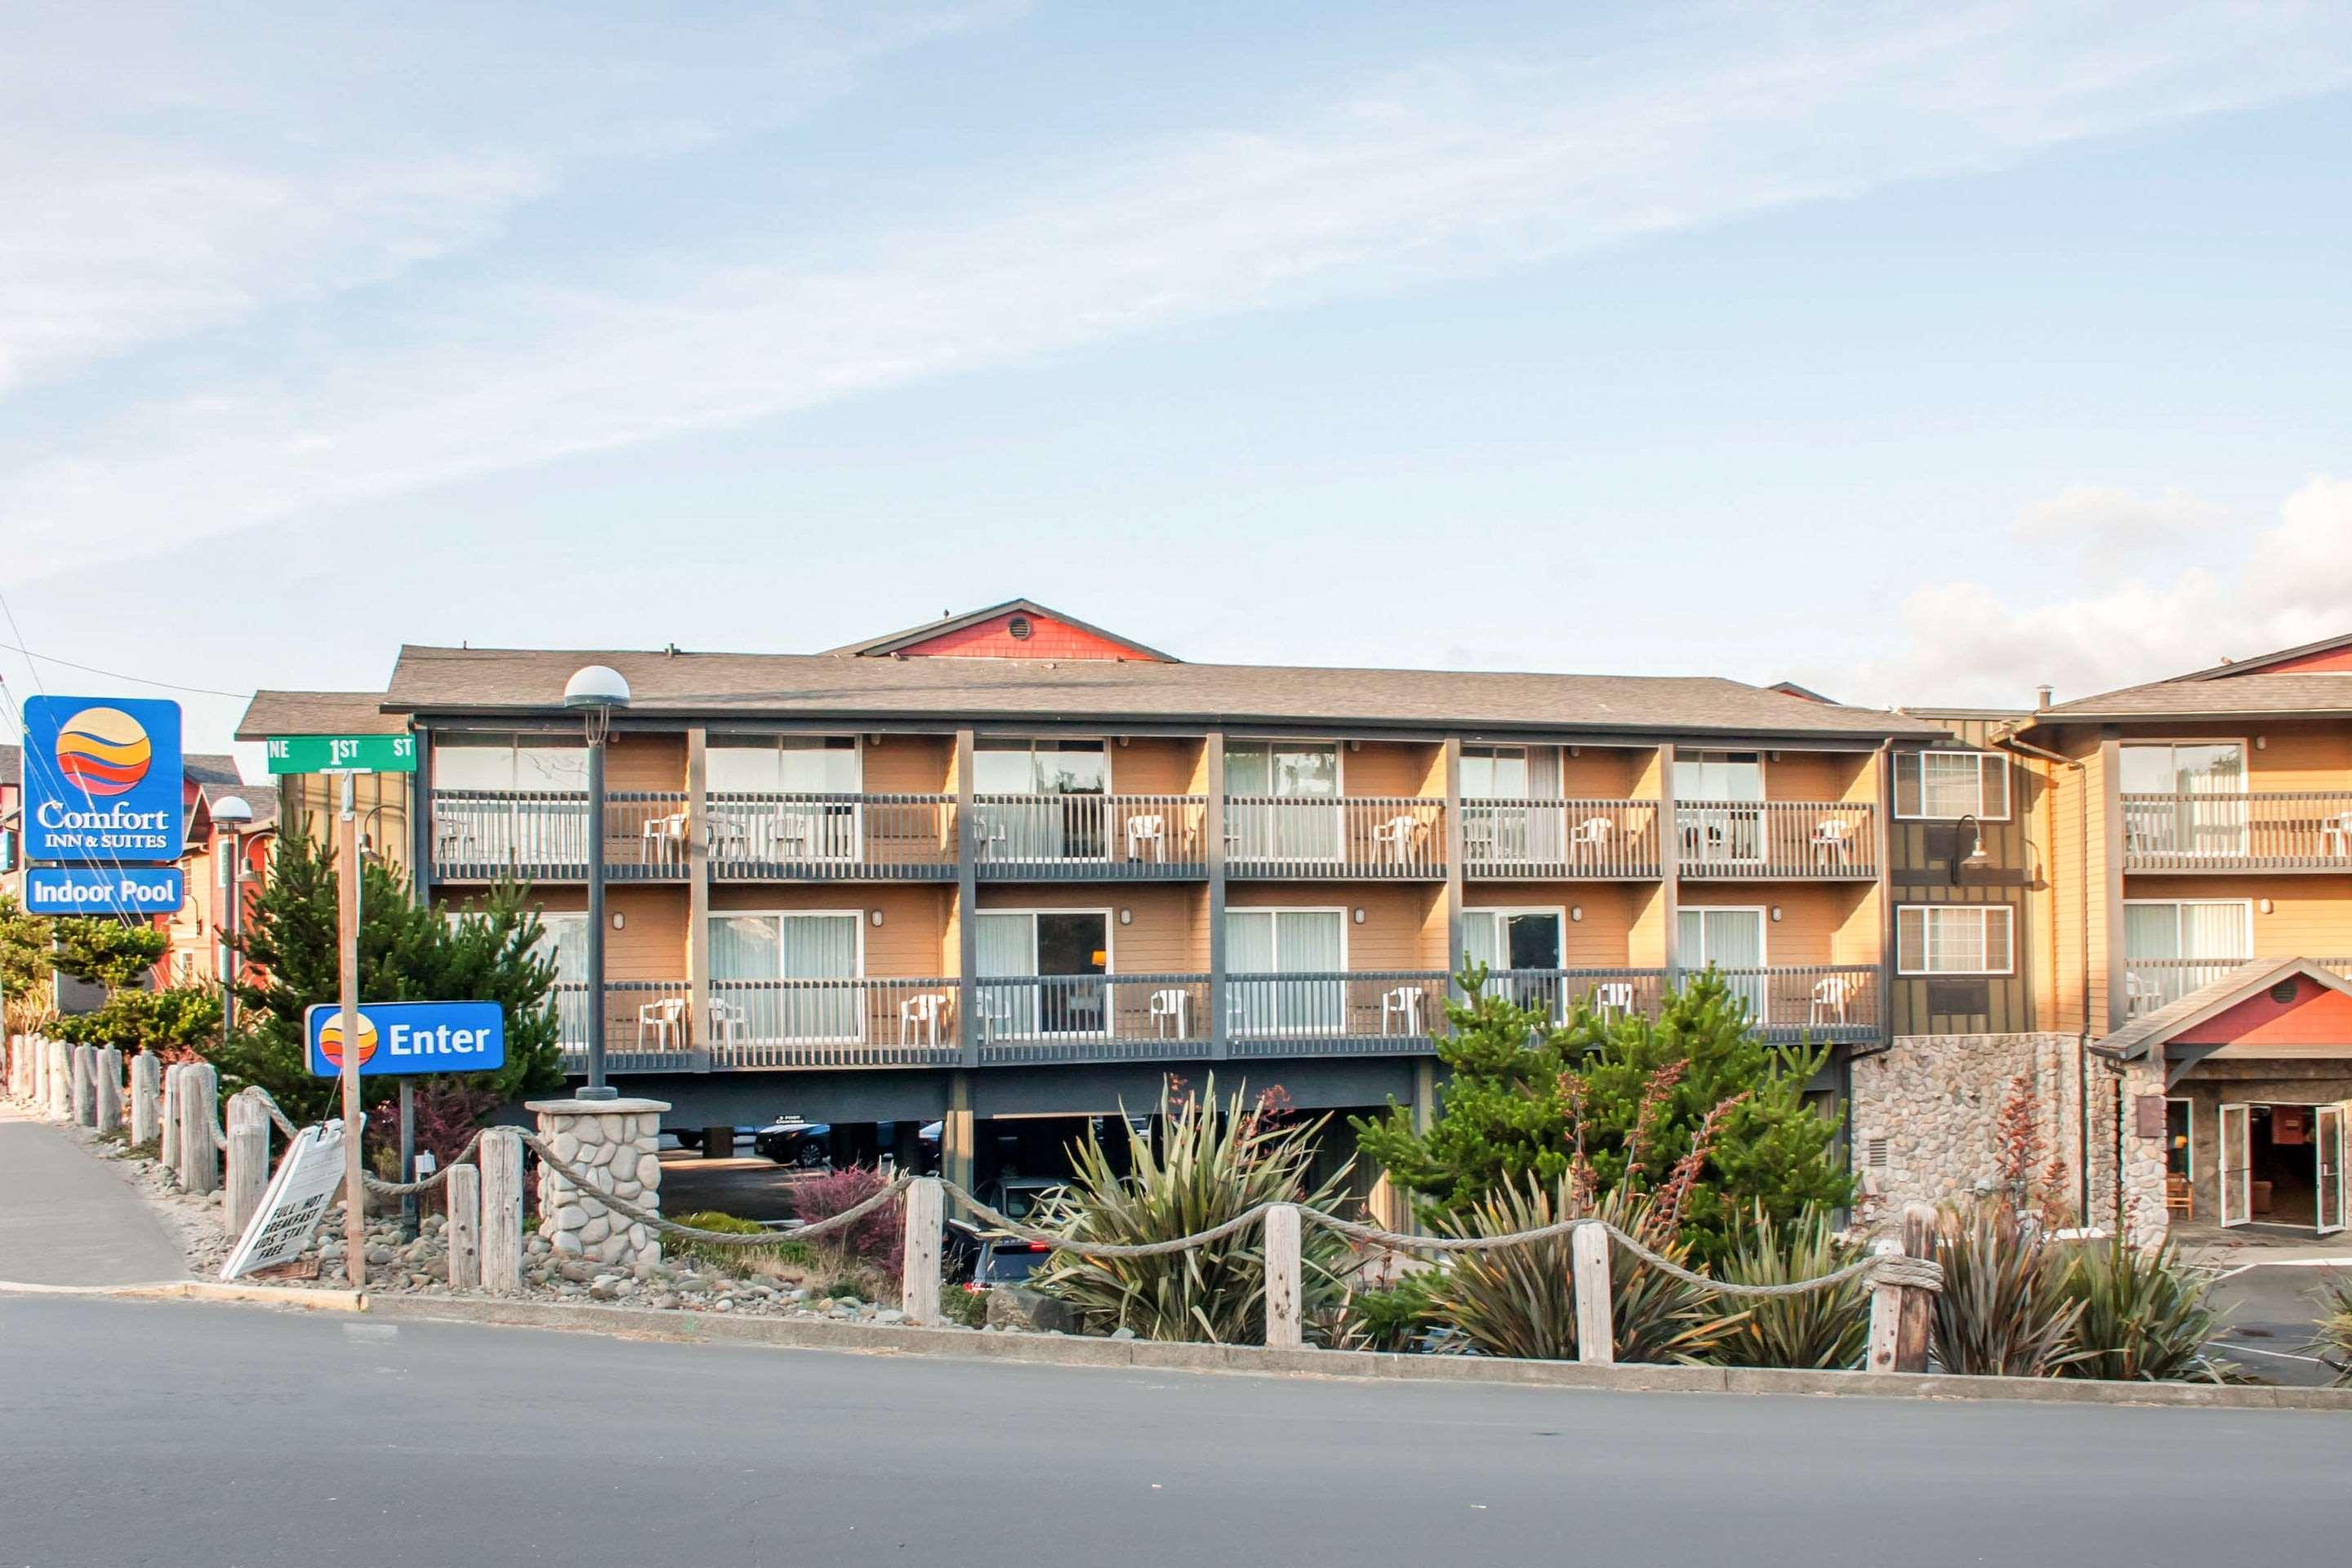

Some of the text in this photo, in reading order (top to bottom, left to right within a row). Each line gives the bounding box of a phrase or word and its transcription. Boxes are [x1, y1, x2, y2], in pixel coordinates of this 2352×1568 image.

[268, 738, 412, 765] NE 1ST ST
[38, 800, 170, 831] Comfort
[45, 834, 167, 849] INN & SUITES
[34, 878, 176, 903] Indoor Pool
[389, 1024, 492, 1056] Enter
[271, 1194, 324, 1220] FULL HOT
[252, 1224, 309, 1250] KIDS STAY
[256, 1242, 287, 1261] FREE
